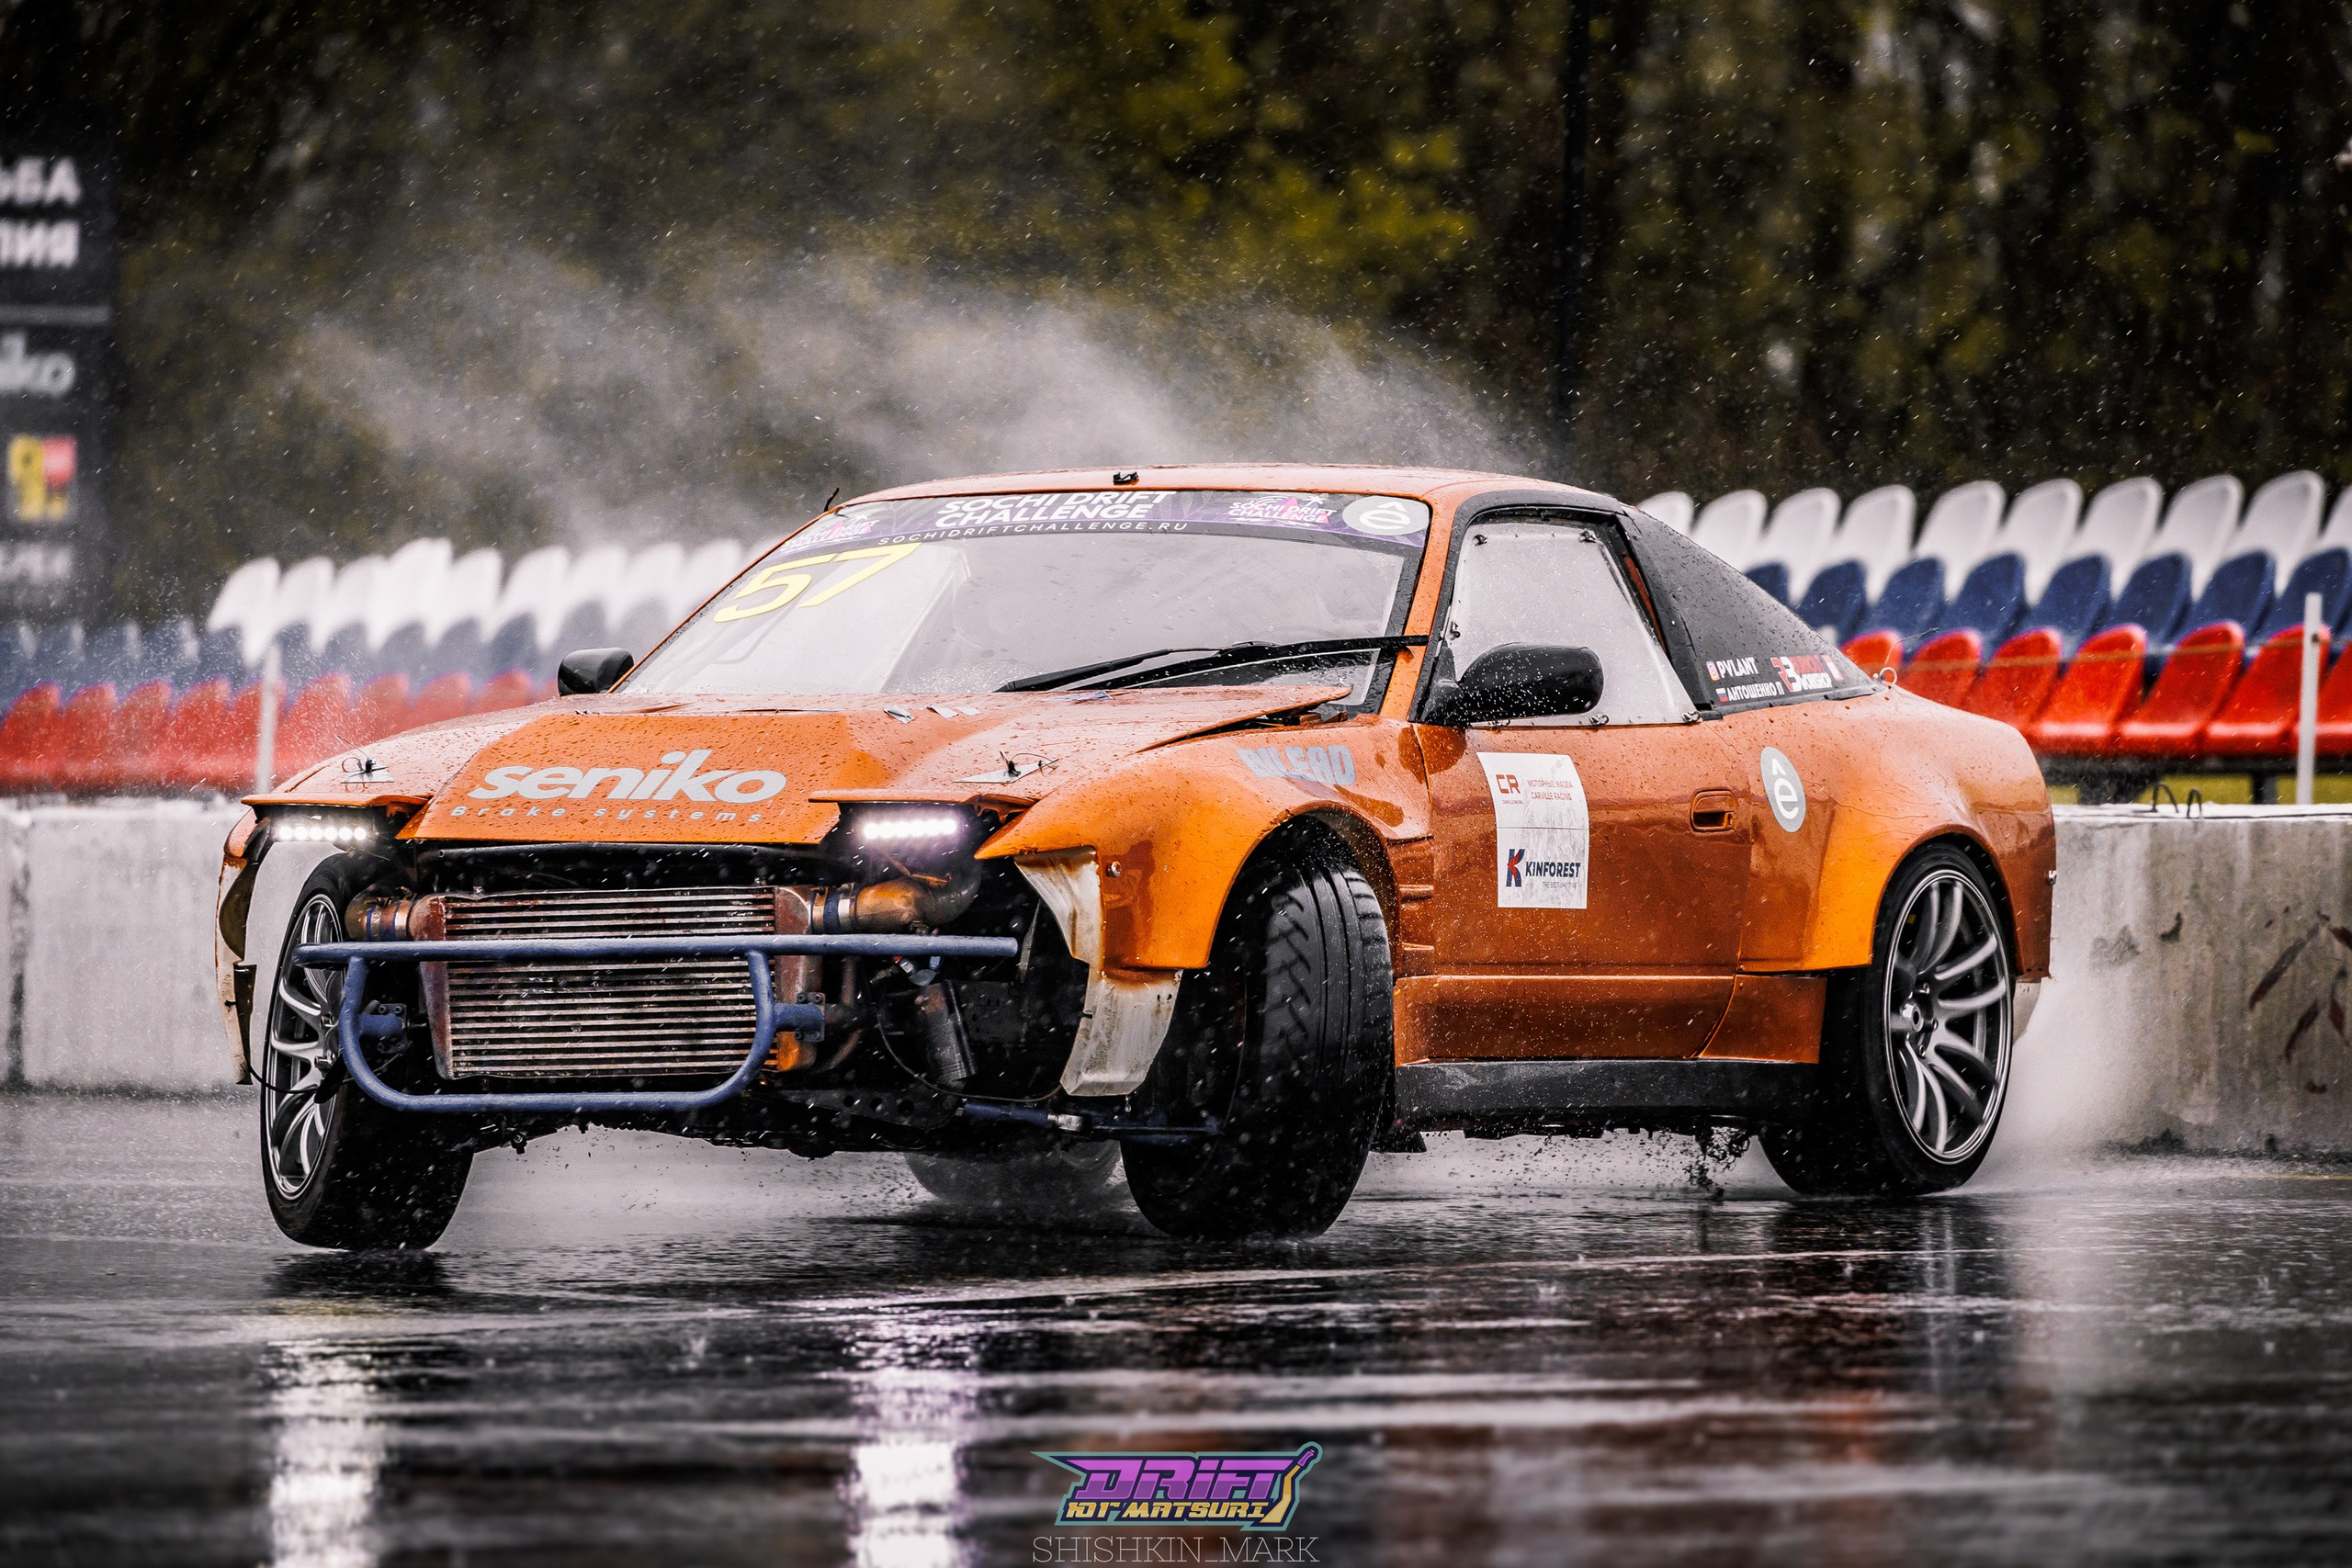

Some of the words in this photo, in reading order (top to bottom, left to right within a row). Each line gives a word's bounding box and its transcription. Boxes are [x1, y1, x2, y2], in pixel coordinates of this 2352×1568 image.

[937, 493, 1062, 514] SOCHI
[1062, 490, 1178, 506] DRIFT
[1229, 502, 1283, 513] SOCHI
[1289, 505, 1337, 516] DRIFT
[935, 503, 1154, 528] CHALLENGE
[1228, 509, 1328, 524] CHALLENGE
[878, 521, 1189, 546] SOCHIDRIFTCHALLENGE.RU
[714, 542, 922, 623] 57
[467, 750, 787, 804] seniko
[450, 806, 565, 818] Brake
[594, 806, 762, 822] systems
[1525, 861, 1581, 877] KINFOREST
